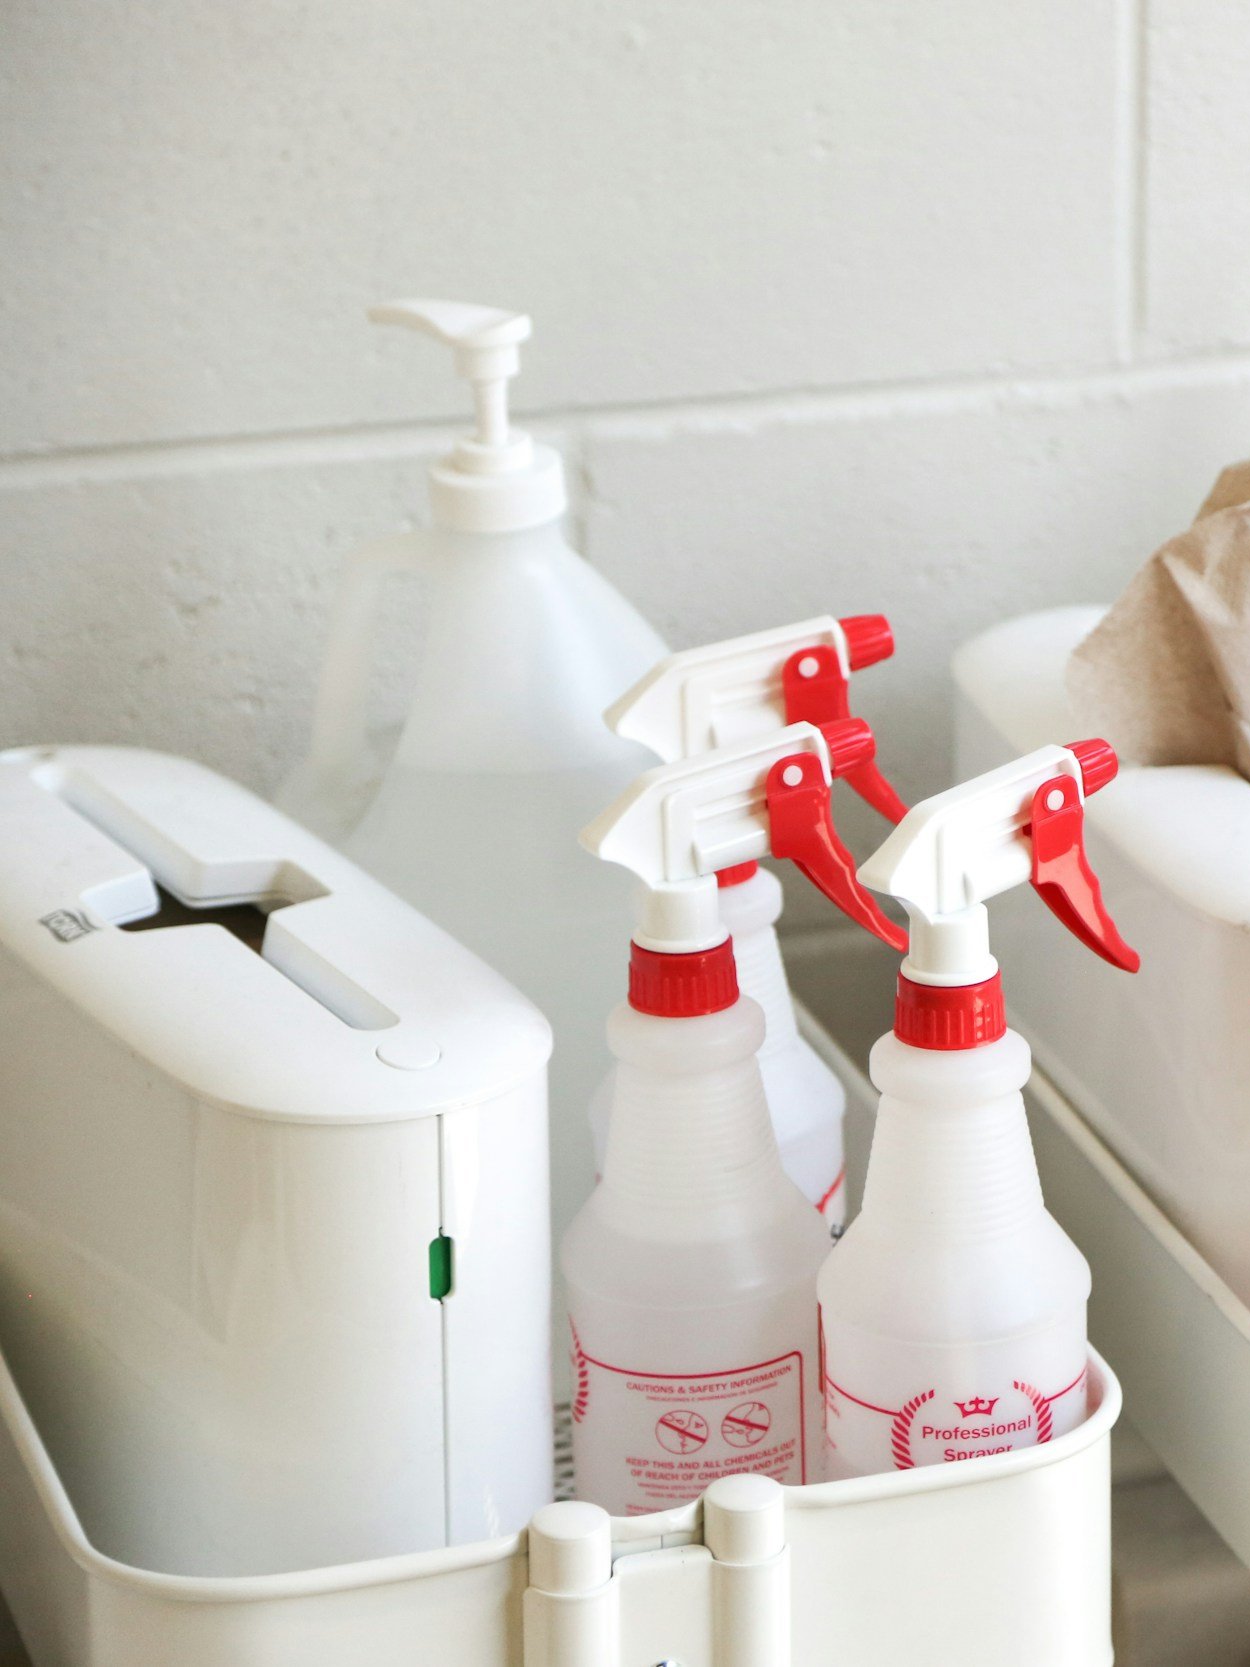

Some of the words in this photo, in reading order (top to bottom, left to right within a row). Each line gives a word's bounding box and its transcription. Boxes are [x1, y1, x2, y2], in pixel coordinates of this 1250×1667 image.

[626, 1382, 674, 1394] CAUTIONS
[677, 1385, 686, 1394] &
[688, 1382, 728, 1394] SAFETY
[730, 1364, 792, 1389] INFORMATION
[922, 1415, 1032, 1440] Professional
[625, 1456, 649, 1466] KEEP
[652, 1461, 675, 1469] THIS
[677, 1461, 699, 1470] AND
[703, 1460, 721, 1469] ALL
[724, 1447, 778, 1467] CHEMICALS
[630, 1468, 643, 1477] OF
[645, 1470, 679, 1480] REACH
[681, 1473, 695, 1481] OF
[698, 1467, 749, 1480] CHILDREN
[752, 1459, 773, 1471] AND
[774, 1451, 795, 1464] PETS
